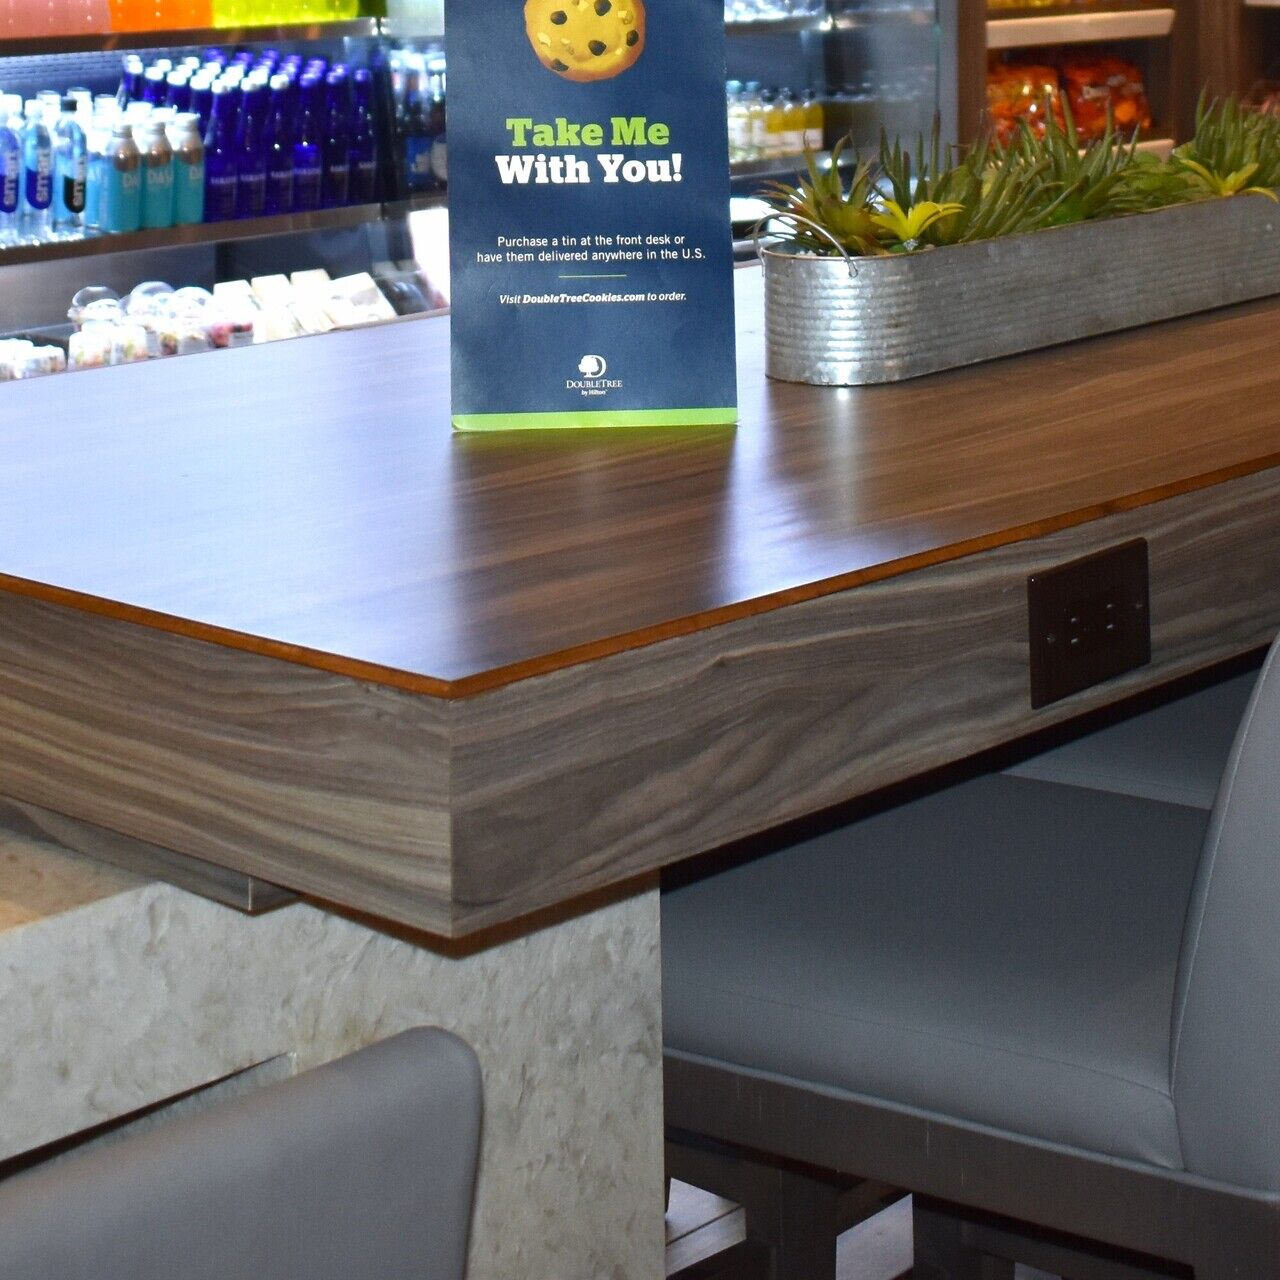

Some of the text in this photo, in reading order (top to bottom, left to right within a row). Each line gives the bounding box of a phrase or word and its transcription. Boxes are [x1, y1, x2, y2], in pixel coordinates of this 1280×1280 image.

[506, 117, 670, 147] Take Me
[3, 151, 18, 207] smart
[36, 150, 50, 203] smart
[495, 153, 682, 184] With You!
[497, 234, 686, 247] Purchase a tin at the front desk or
[476, 248, 706, 263] have them delivered anywhere in the U.S.
[499, 291, 687, 304] Visit DoubleTreeCookies.com to order.
[581, 389, 588, 397] by
